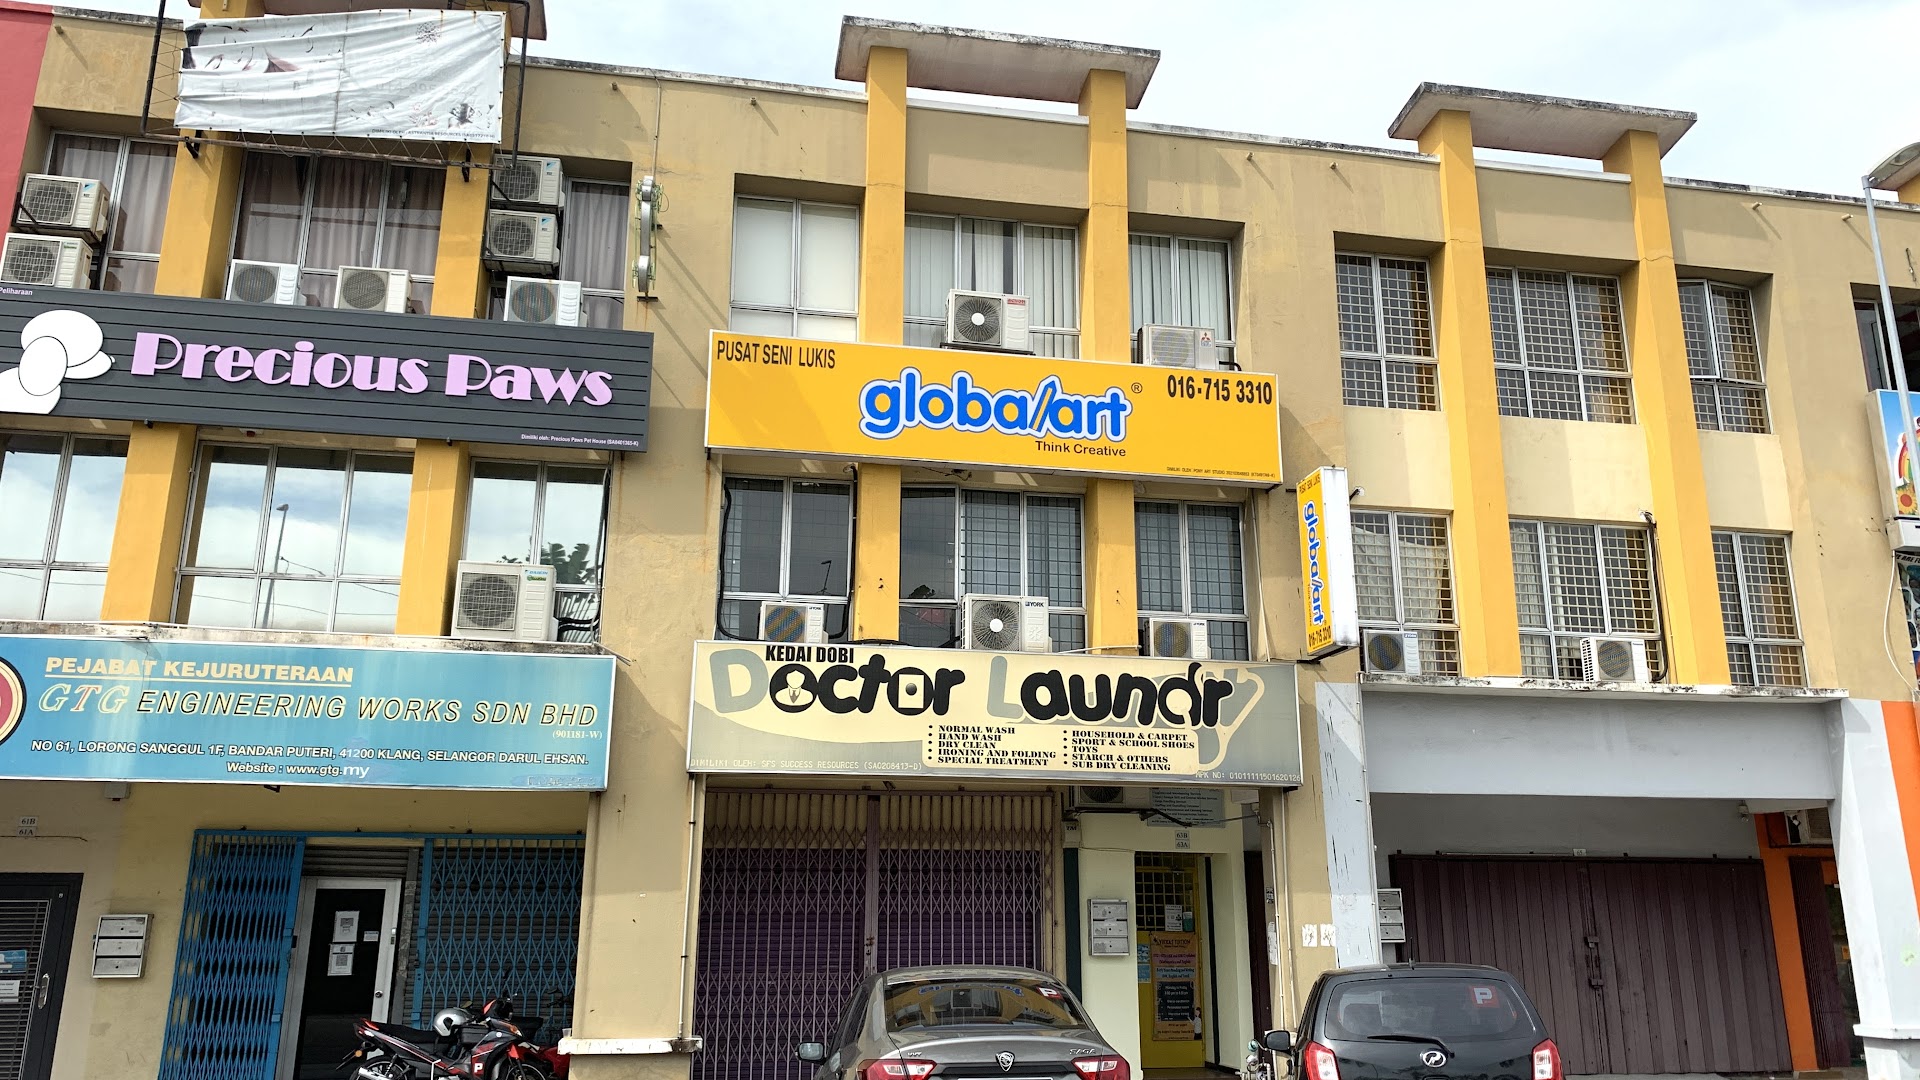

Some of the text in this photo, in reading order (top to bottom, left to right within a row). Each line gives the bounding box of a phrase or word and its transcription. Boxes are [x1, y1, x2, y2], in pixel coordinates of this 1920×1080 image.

[717, 340, 836, 369] PUSAT SENI LUKIS
[131, 332, 614, 407] Precious Paws
[1167, 374, 1273, 405] 016-715 3310
[1035, 440, 1127, 457] Think Creative
[765, 645, 855, 664] KEDAI DOBI
[45, 657, 353, 683] PEJABAT KEJURUTERAAN
[709, 648, 966, 717] Doctor
[38, 682, 599, 728] GTG ENGINEERING WORKS SDN BHD
[552, 729, 603, 740] (901181-W)
[938, 724, 1016, 735] NORMAL WASH
[938, 732, 1002, 742] HAND WASH
[1072, 730, 1188, 741] HOUSEHOLD & CARPET
[938, 740, 997, 749] DRY CLEAN
[1072, 738, 1195, 749] SPORT & SCHOOL SHOES
[1072, 745, 1098, 753] TOYS
[31, 740, 589, 766] NO 61, LORONG SANGGUL 1F, BANDAR PUTERI, 41200 KLANG, SELANGOR DARUL EHSAN.
[938, 749, 1057, 759] IRONING AND FOLDING
[1072, 753, 1168, 763] STARCH & OTHERS
[690, 758, 728, 768] DIMILIKI
[761, 760, 776, 769] SFS
[780, 760, 815, 769] SUCCESS
[818, 760, 859, 770] RESOURCES
[937, 756, 1049, 766] SPECIAL TREATMENT
[1072, 761, 1171, 771] SUB DRY CLEANING
[227, 762, 276, 773] Website
[286, 763, 370, 778] www.gtg.my
[1212, 771, 1225, 780] NO:
[21, 817, 36, 825] 61B
[18, 828, 34, 836] 61A
[1038, 987, 1057, 997] P
[1473, 987, 1493, 1004] P
[474, 1062, 484, 1073] P
